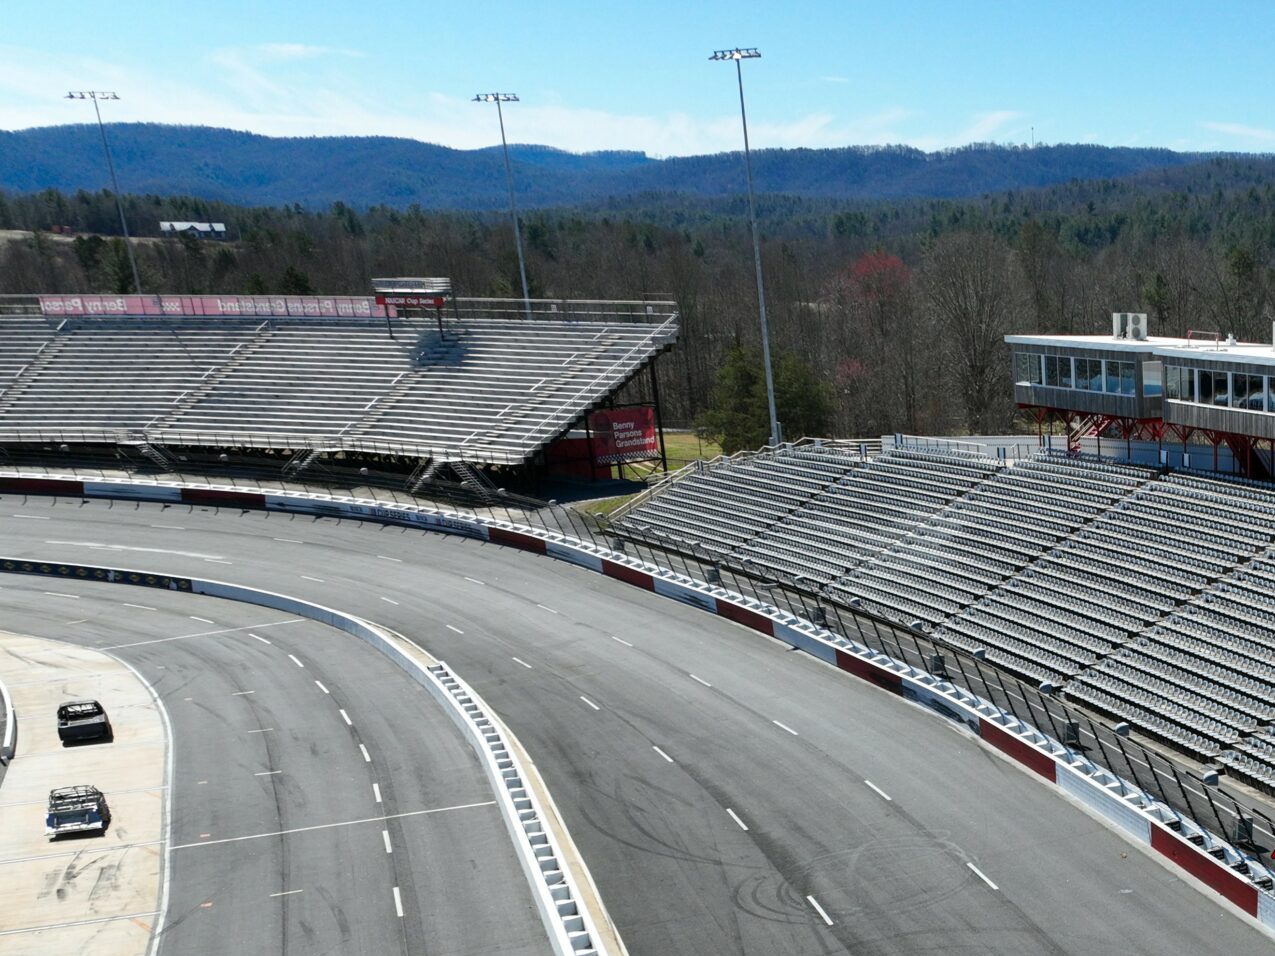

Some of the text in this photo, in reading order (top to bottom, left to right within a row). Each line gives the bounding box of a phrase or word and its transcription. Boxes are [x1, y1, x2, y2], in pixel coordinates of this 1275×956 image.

[612, 421, 635, 430] Benny
[614, 430, 642, 439] Parsons
[615, 436, 655, 448] Grandstand
